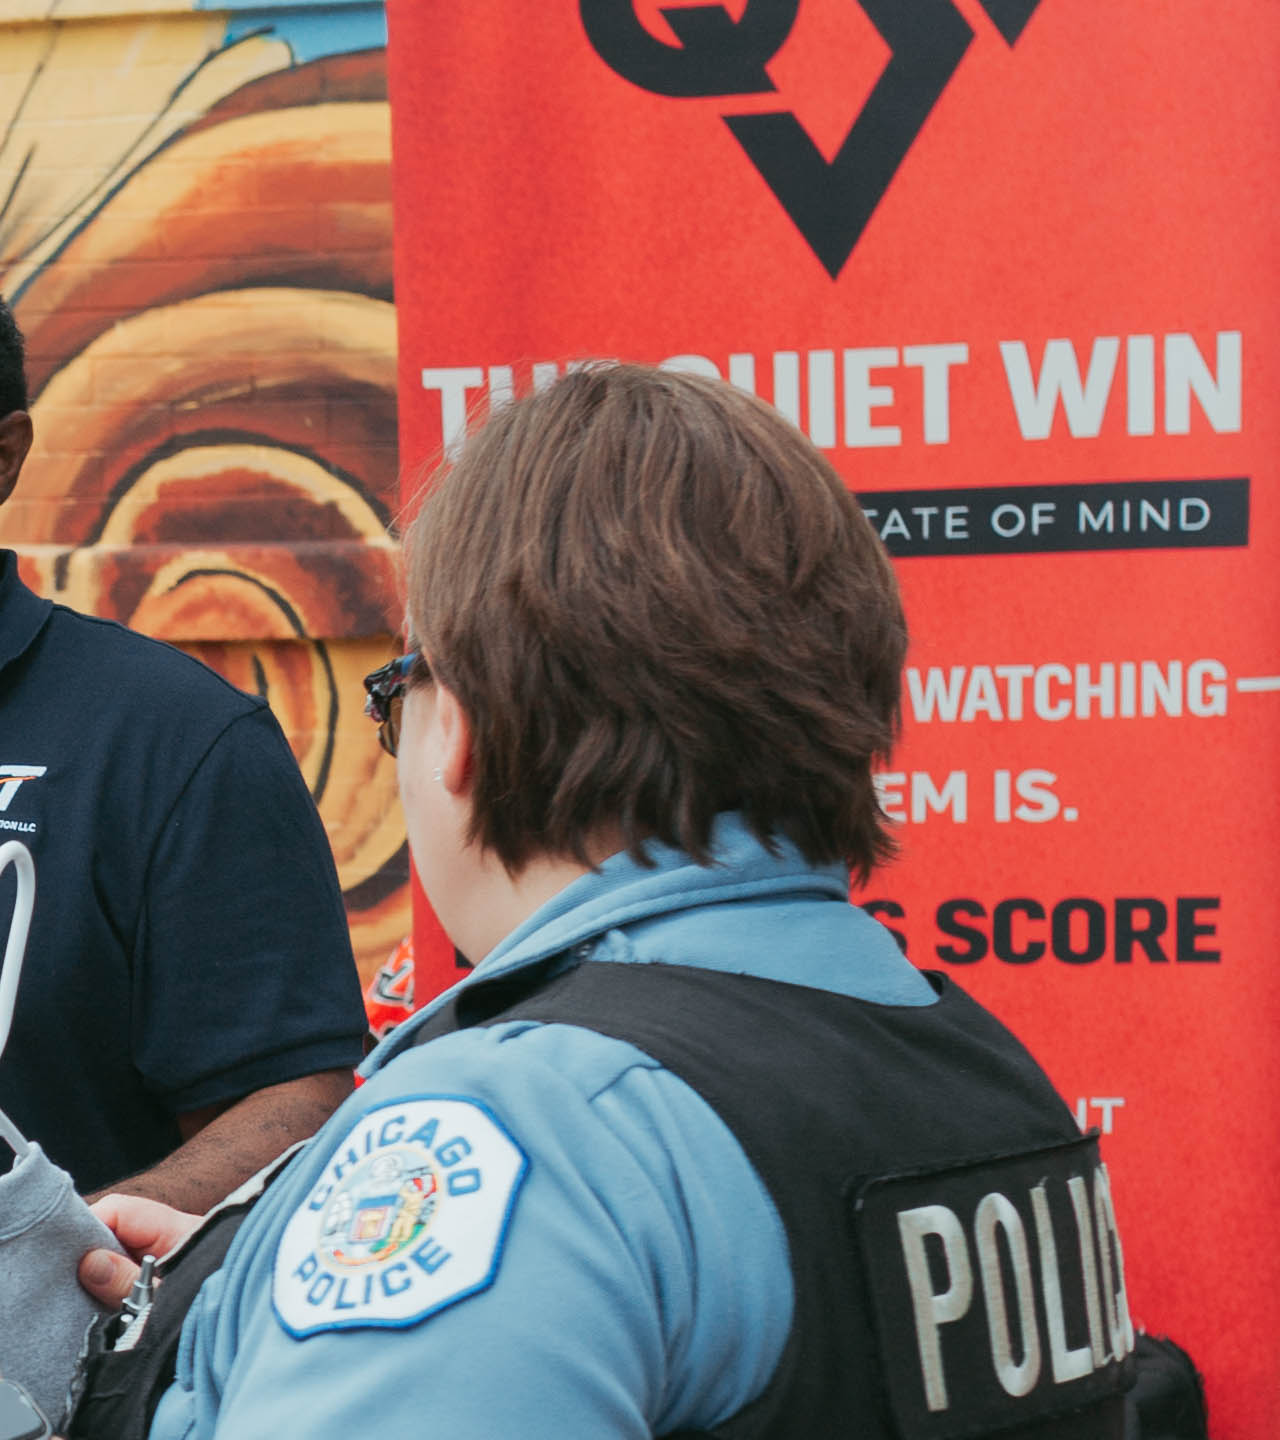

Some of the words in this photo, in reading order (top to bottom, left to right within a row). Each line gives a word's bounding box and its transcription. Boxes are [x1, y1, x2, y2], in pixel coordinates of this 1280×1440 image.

[999, 329, 1242, 441] WIN
[991, 502, 1056, 539] OF
[1077, 496, 1212, 535] MIND
[993, 768, 1080, 824] IS.
[934, 896, 1222, 966] SCORE
[308, 1114, 482, 1213] CHICAGO
[291, 1236, 454, 1311] POLICE
